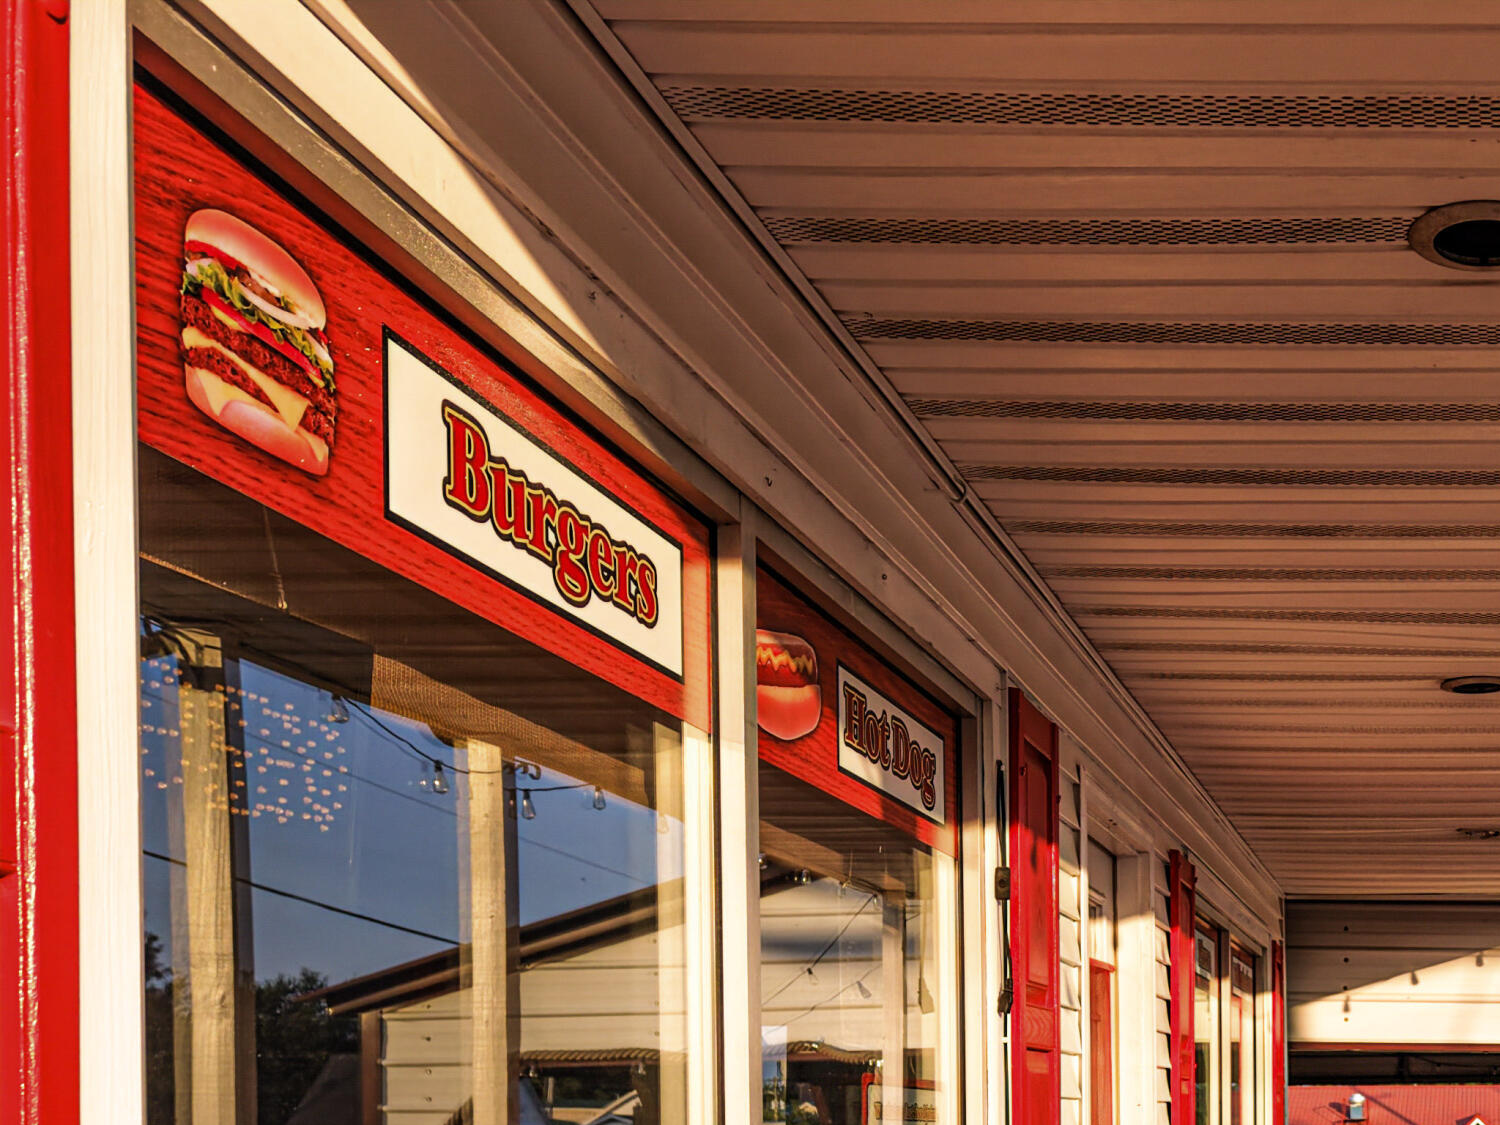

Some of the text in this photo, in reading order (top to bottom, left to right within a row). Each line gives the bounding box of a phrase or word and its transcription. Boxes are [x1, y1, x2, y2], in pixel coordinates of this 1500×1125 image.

[442, 399, 657, 628] Burgers
[844, 681, 936, 811] Hot Dog
